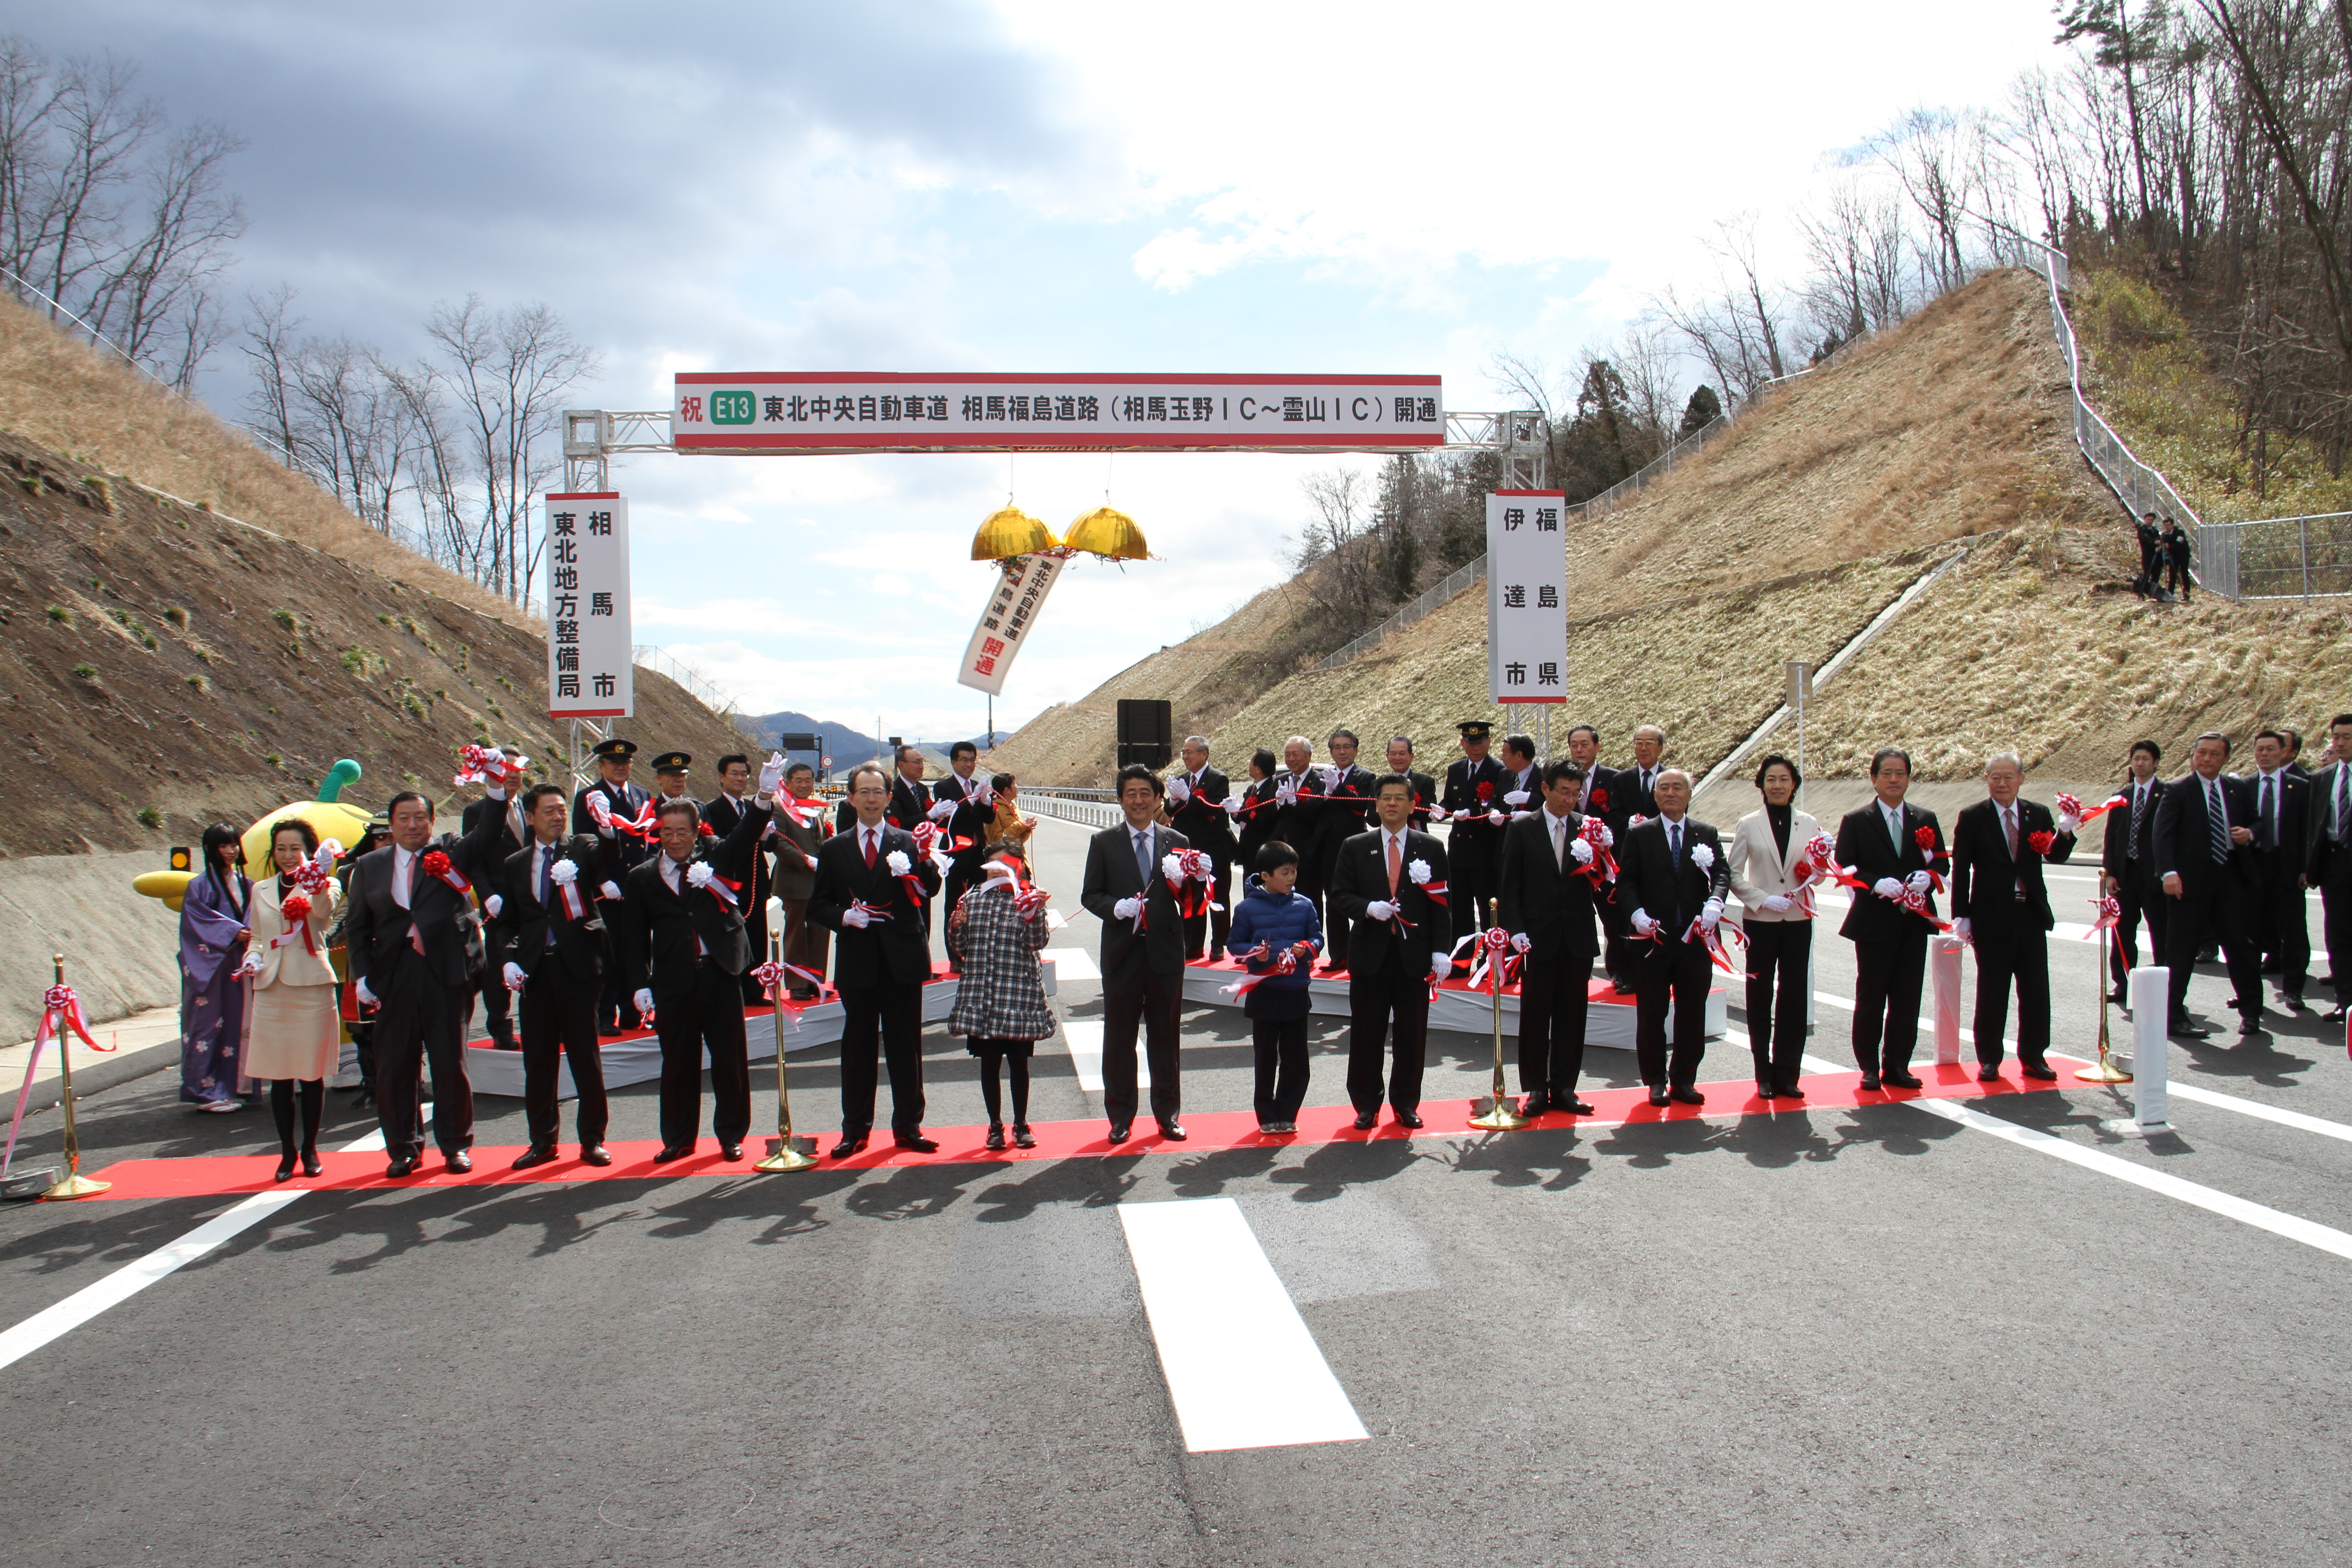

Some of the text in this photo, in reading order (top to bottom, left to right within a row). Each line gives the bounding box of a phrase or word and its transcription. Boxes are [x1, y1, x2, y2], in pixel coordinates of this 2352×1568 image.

[681, 396, 703, 422] 祝
[716, 397, 749, 418] E13
[763, 395, 949, 422] 東北中央自動車道
[553, 511, 580, 699] 東北地方整備局
[588, 510, 616, 698] 相馬市
[974, 636, 1005, 676] 開通
[1003, 559, 1054, 641] 東北中央自動車道
[1503, 507, 1527, 686] 伊達市
[1536, 507, 1559, 686] 福島県
